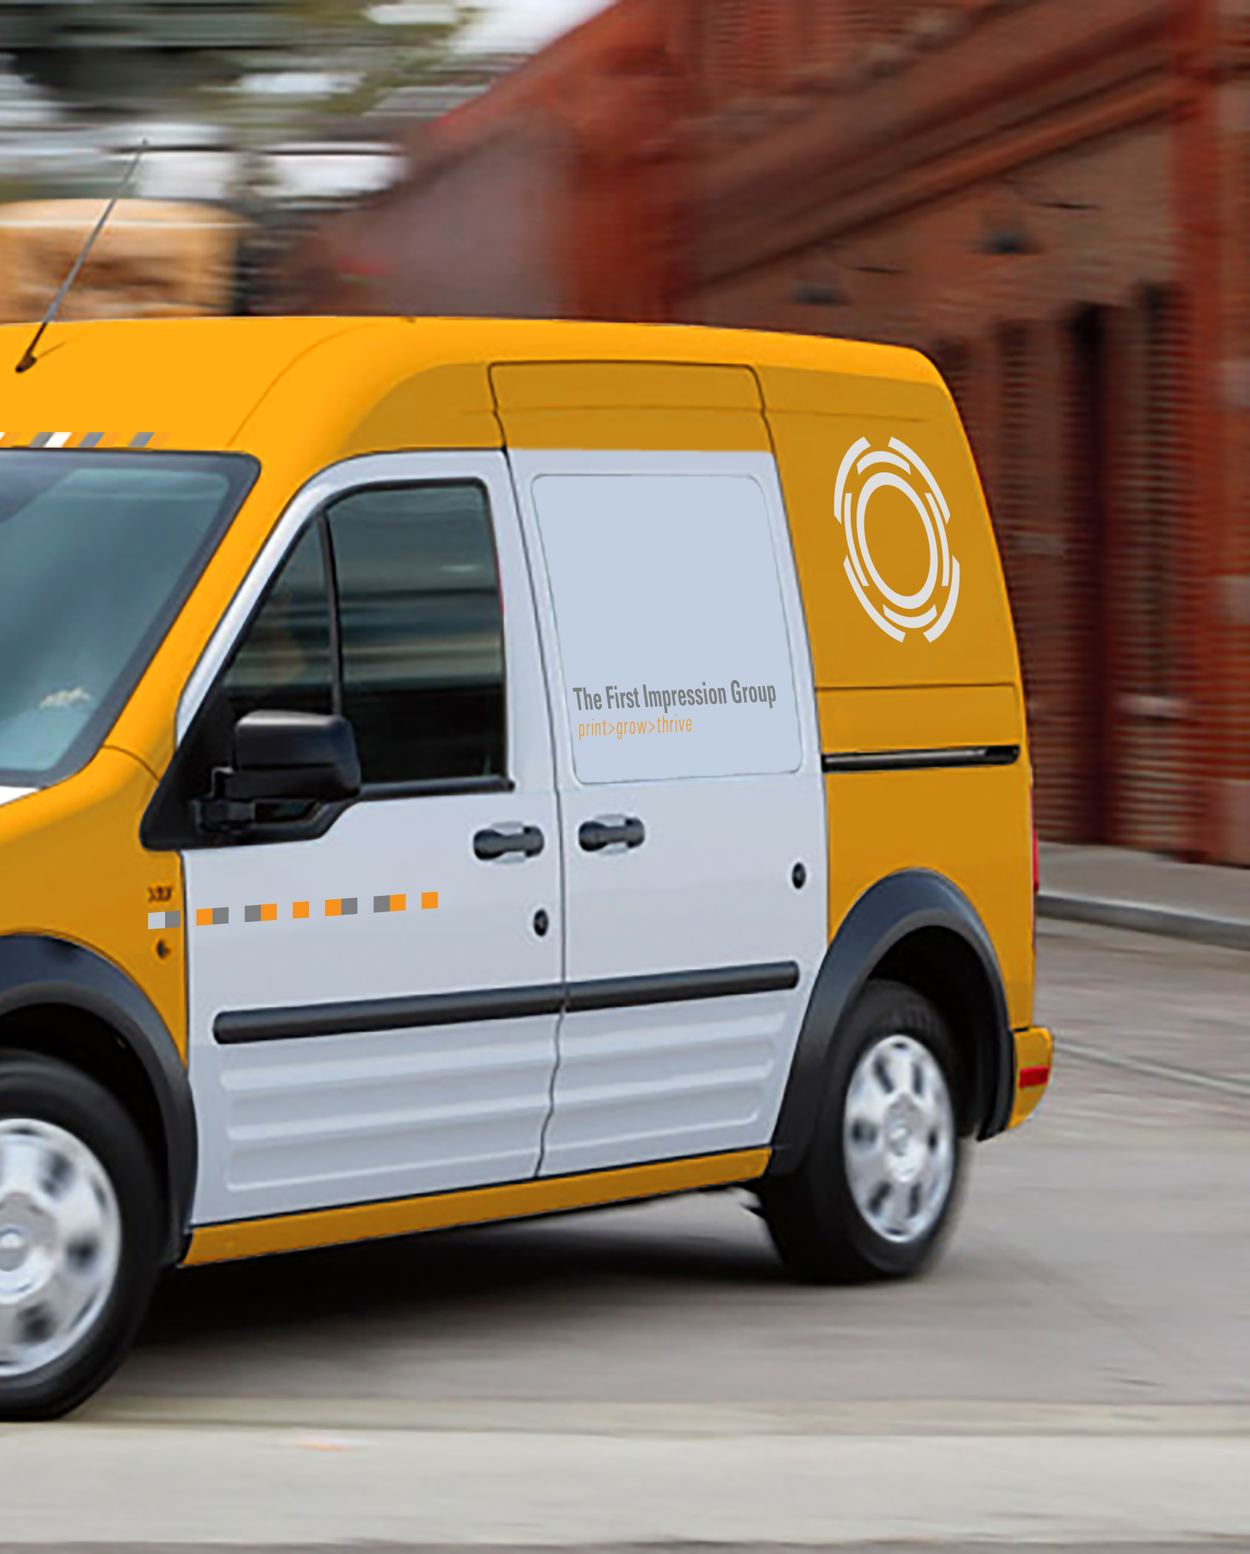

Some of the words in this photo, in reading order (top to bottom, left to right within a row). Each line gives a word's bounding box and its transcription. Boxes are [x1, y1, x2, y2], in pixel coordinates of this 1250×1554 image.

[572, 686, 603, 711] The
[605, 685, 641, 709] First
[642, 681, 728, 714] Impression
[730, 679, 777, 709] Group
[578, 714, 693, 741] print>grow>thrive
